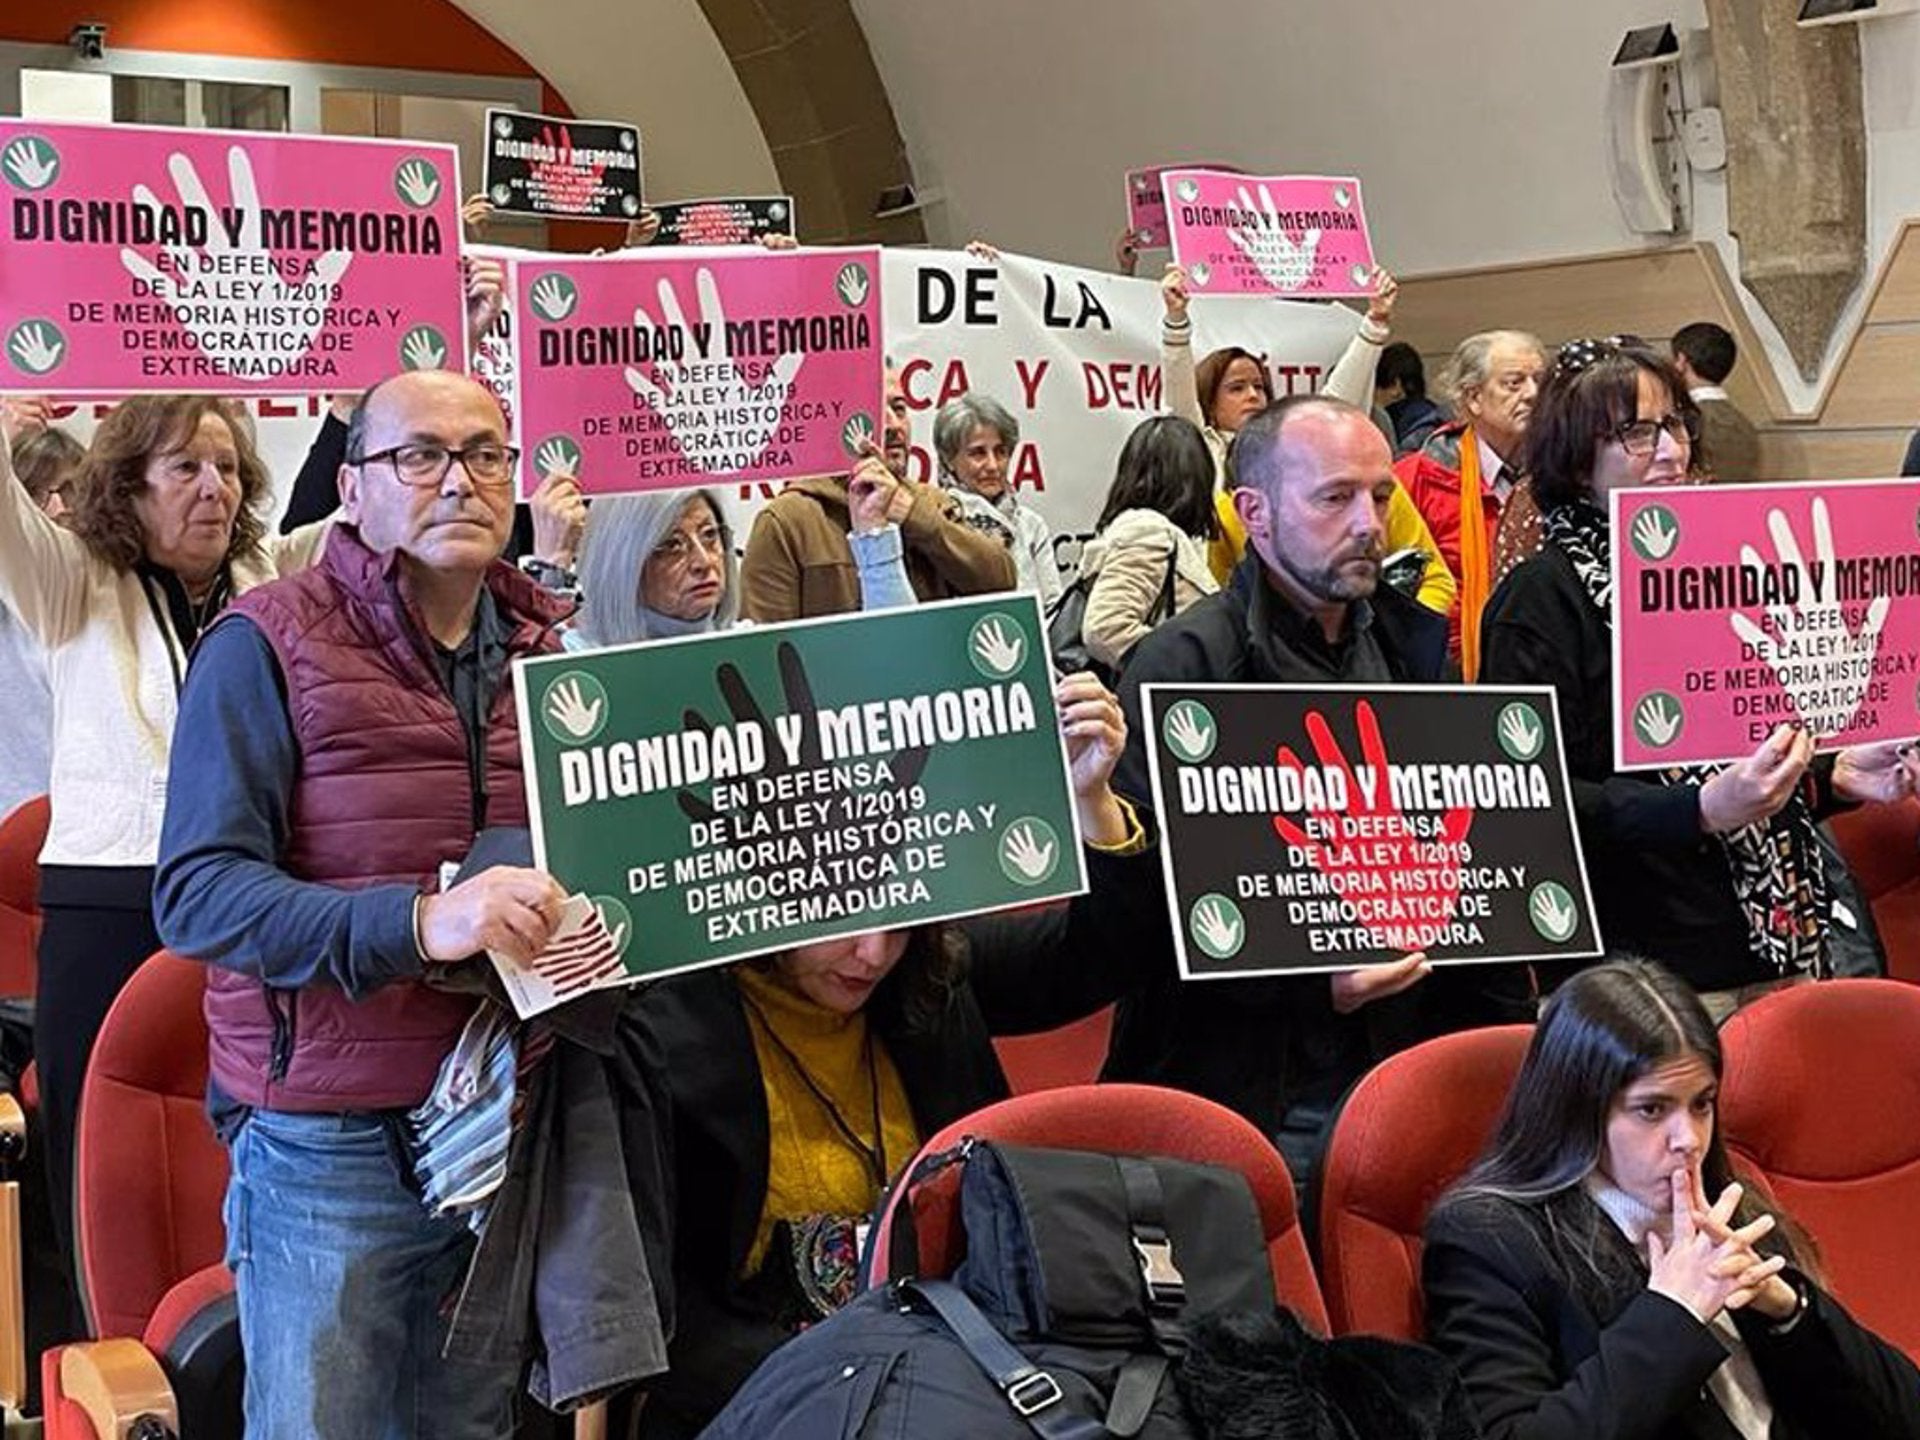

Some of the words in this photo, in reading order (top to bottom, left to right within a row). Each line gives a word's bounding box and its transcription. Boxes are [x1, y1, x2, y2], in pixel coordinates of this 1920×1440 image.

[13, 198, 208, 248] DIGNIDAD
[223, 208, 245, 248] Y
[261, 209, 442, 255] MEMORIA
[1278, 211, 1359, 231] MEMORIA
[156, 253, 189, 273] EN
[200, 254, 319, 276] DEFENSA
[133, 278, 166, 298] DE
[176, 280, 206, 299] LA
[216, 280, 264, 300] LEY
[272, 282, 342, 302] 1/2019
[917, 268, 998, 325] DE
[1043, 273, 1112, 330] LA
[69, 303, 104, 323] DE
[113, 304, 239, 326] MEMORIA
[245, 302, 381, 327] HISTÓRICA
[386, 309, 401, 328] Y
[123, 325, 314, 352] DEMOCRÁTICA
[321, 333, 353, 352] DE
[539, 324, 684, 367] DIGNIDAD
[695, 322, 711, 359] Y
[725, 313, 870, 358] MEMORIA
[142, 356, 338, 377] EXTREMADURA
[650, 368, 674, 385] EN
[678, 362, 776, 383] DEFENSA
[633, 392, 658, 410] DE
[665, 391, 689, 408] LA
[690, 387, 728, 406] LEY
[737, 382, 797, 402] 1/2019
[1015, 360, 1049, 410] Y
[583, 417, 612, 436] DE
[618, 410, 708, 434] MEMORIA
[714, 401, 828, 428] HISTÓRICA
[829, 400, 843, 419] Y
[625, 428, 773, 458] DEMOCRÁTICA
[779, 425, 806, 444] DE
[640, 451, 794, 479] EXTREMADURA
[1640, 562, 1800, 612] DIGNIDAD
[1809, 561, 1824, 603] Y
[1761, 613, 1787, 634] EN
[1794, 608, 1870, 632] DEFENSA
[1741, 642, 1770, 662] DE
[1777, 641, 1801, 660] LA
[1806, 638, 1839, 657] LEY
[1685, 671, 1717, 692] DE
[1724, 663, 1820, 689] MEMORIA
[1907, 654, 1918, 671] Y
[1868, 682, 1889, 702] DE
[560, 723, 766, 807] DIGNIDAD
[777, 715, 801, 766] Y
[818, 682, 1036, 761] MEMORIA
[712, 786, 748, 813] EN
[757, 760, 895, 805] DEFENSA
[1178, 765, 1347, 814] DIGNIDAD
[1354, 765, 1377, 809] Y
[1389, 763, 1552, 809] MEMORIA
[690, 820, 727, 849] DE
[735, 814, 772, 841] LA
[778, 800, 831, 835] LEY
[840, 787, 927, 826] 1/2019
[1305, 818, 1337, 840] EN
[1341, 815, 1447, 839] DEFENSA
[628, 865, 668, 895] DE
[674, 841, 807, 885] MEMORIA
[812, 807, 974, 859] HISTÓRICA
[976, 803, 997, 829] Y
[1288, 846, 1319, 869] DE
[1326, 845, 1355, 867] LA
[1361, 843, 1404, 866] LEY
[1409, 840, 1472, 864] 1/2019
[686, 851, 898, 915] DEMOCRÁTICA
[905, 843, 946, 872] DE
[1237, 875, 1272, 899] DE
[1277, 872, 1386, 897] MEMORIA
[1390, 864, 1507, 895] HISTÓRICA
[1511, 866, 1527, 887] Y
[707, 880, 930, 943] EXTREMADURA
[1287, 894, 1457, 925] DEMOCRÁTICA
[1459, 895, 1492, 918] DE
[1309, 924, 1484, 953] EXTREMADURA
